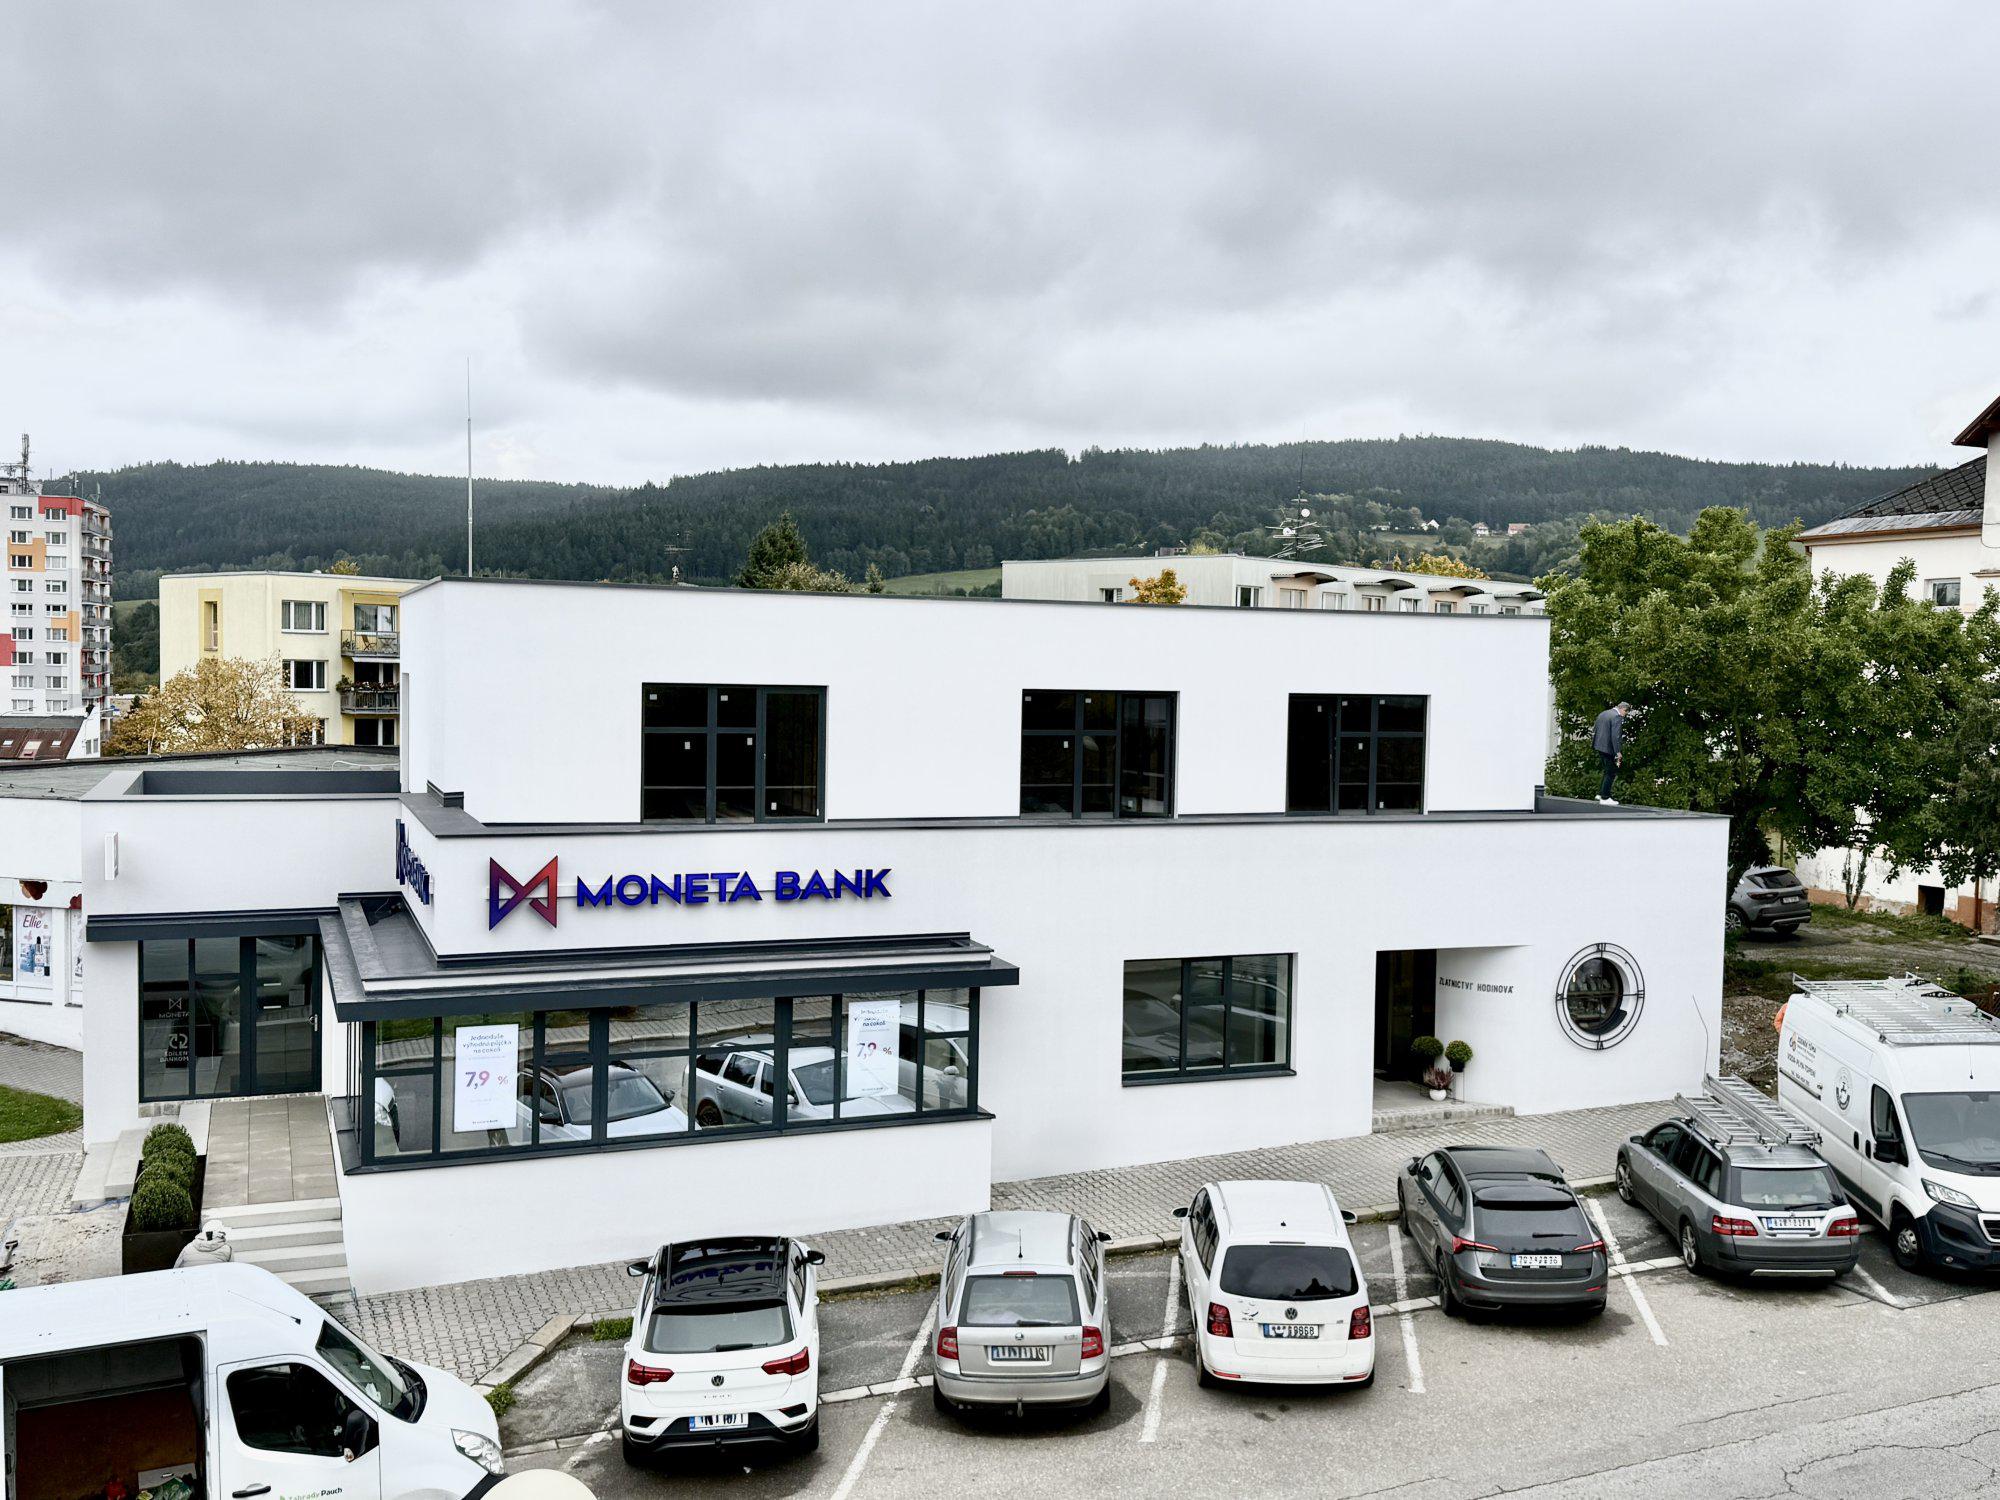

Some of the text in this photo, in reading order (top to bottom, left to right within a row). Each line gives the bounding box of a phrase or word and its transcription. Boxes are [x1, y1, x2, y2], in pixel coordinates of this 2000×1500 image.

[577, 868, 893, 908] MONETA BANK
[22, 914, 42, 928] Ellie
[465, 1070, 509, 1089] 7,9 %
